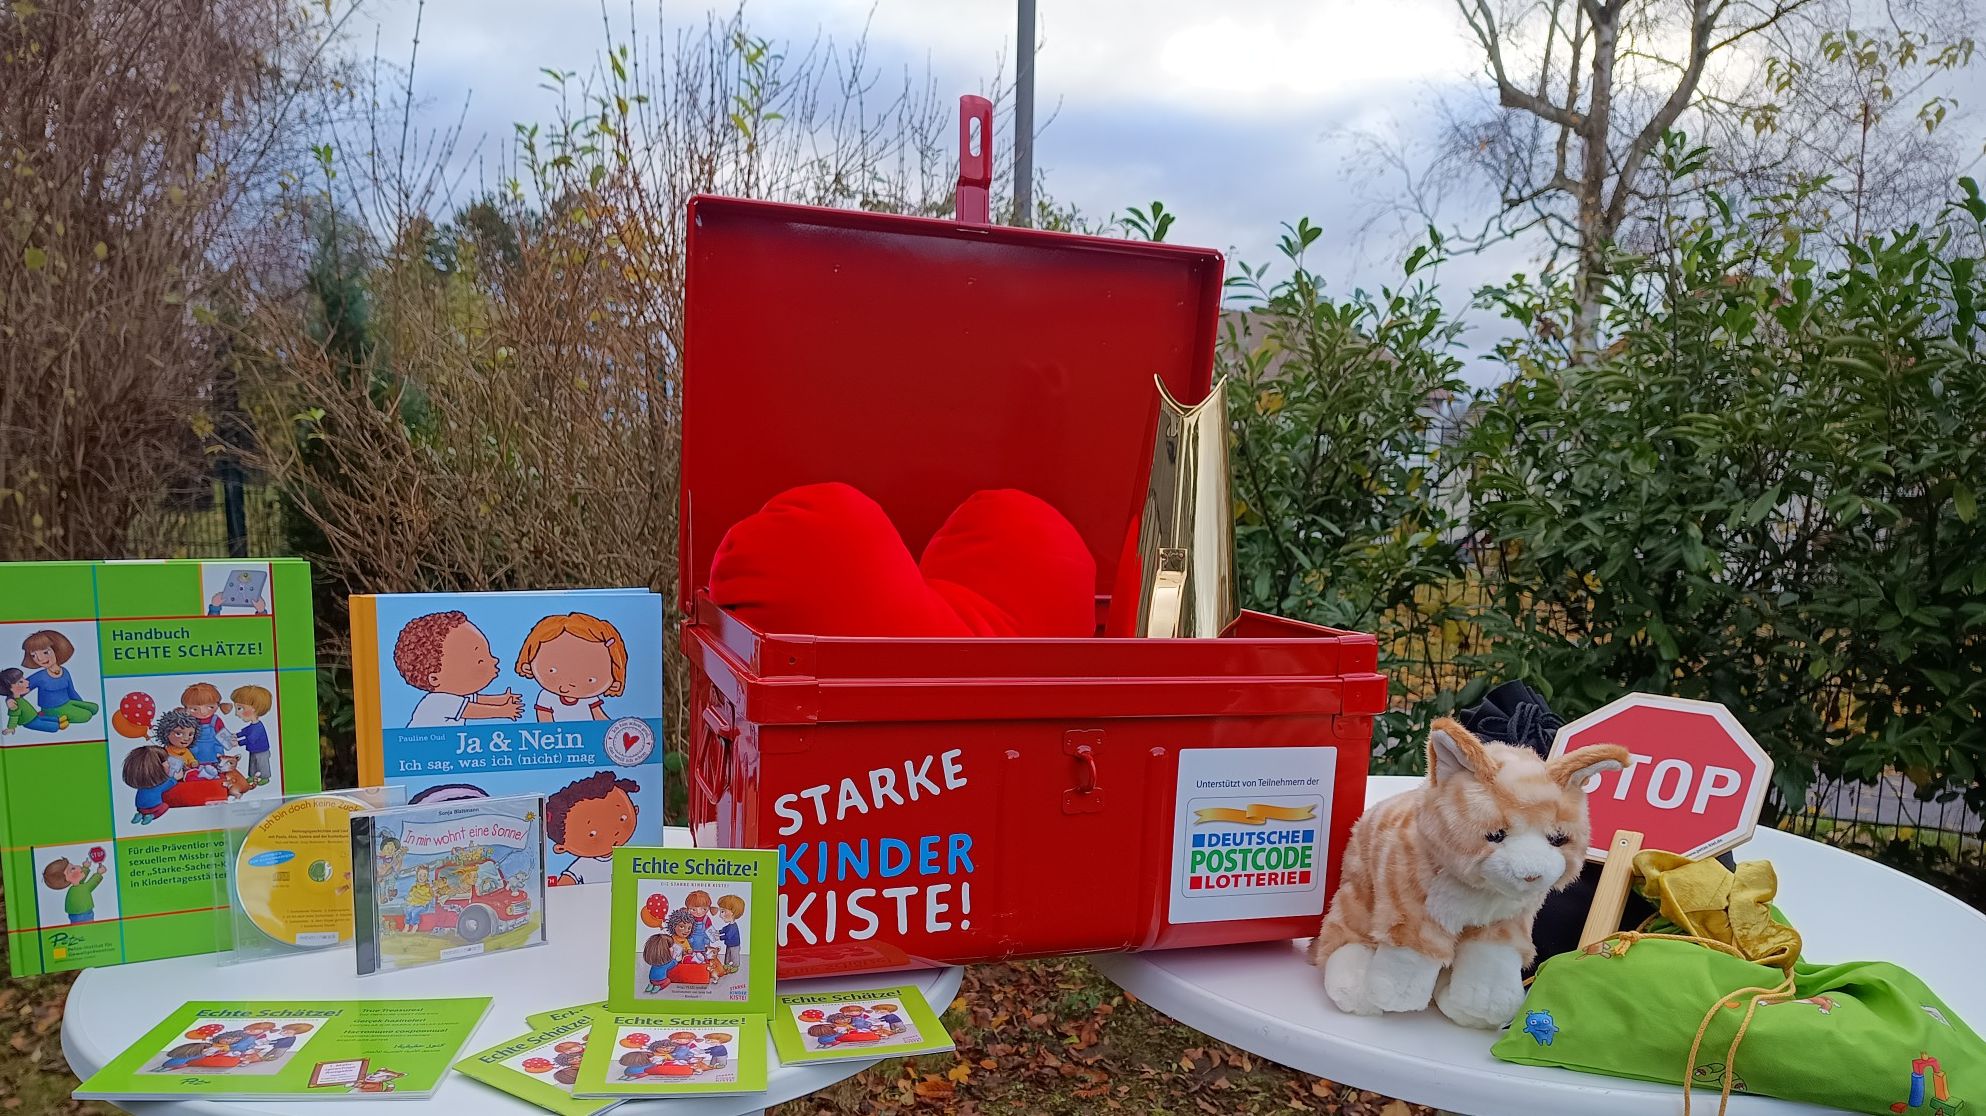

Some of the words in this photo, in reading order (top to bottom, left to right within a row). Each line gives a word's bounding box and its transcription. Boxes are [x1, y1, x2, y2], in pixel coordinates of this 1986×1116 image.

[112, 627, 190, 641] Handbuch
[114, 646, 172, 660] ECHTE
[178, 641, 263, 658] SCHÄTZE!
[456, 732, 483, 755] Ja
[489, 731, 513, 752] &
[518, 727, 585, 751] Nein
[399, 760, 422, 771] Ich
[427, 760, 454, 772] sag,
[459, 757, 487, 768] was
[491, 755, 513, 767] ich
[518, 752, 562, 766] (nicht)
[567, 753, 595, 764] mag
[774, 749, 968, 836] STARKE
[1196, 779, 1241, 789] Unterstützt
[1242, 780, 1257, 788] von
[1258, 778, 1305, 787] Teilnehmern
[1306, 778, 1320, 786] der
[259, 818, 275, 832] Ich
[272, 810, 287, 822] bin
[288, 801, 312, 814] doch
[403, 829, 415, 845] In
[416, 833, 432, 846] mir
[433, 826, 466, 847] wohnt
[469, 825, 489, 838] eine
[1207, 830, 1301, 847] DEUTSCHE
[128, 847, 143, 855] Für
[145, 845, 160, 854] die
[129, 855, 177, 866] sexuellem
[632, 857, 679, 875] Echte
[684, 858, 758, 877] Schätze!
[778, 833, 975, 886] KINDER
[1190, 845, 1313, 874] POSTCODE
[130, 869, 145, 877] der
[1204, 871, 1297, 889] LOTTERIE
[130, 880, 140, 888] in
[778, 882, 971, 947] KISTE!
[782, 994, 828, 1004] Echte
[832, 989, 902, 1002] Schätze!
[196, 1009, 252, 1017] Echte
[255, 1009, 343, 1017] Schätze!
[614, 1016, 663, 1026] Echte
[668, 1017, 746, 1026] Schätze!
[479, 1042, 528, 1064] Echte
[527, 1015, 595, 1045] Schätze!
